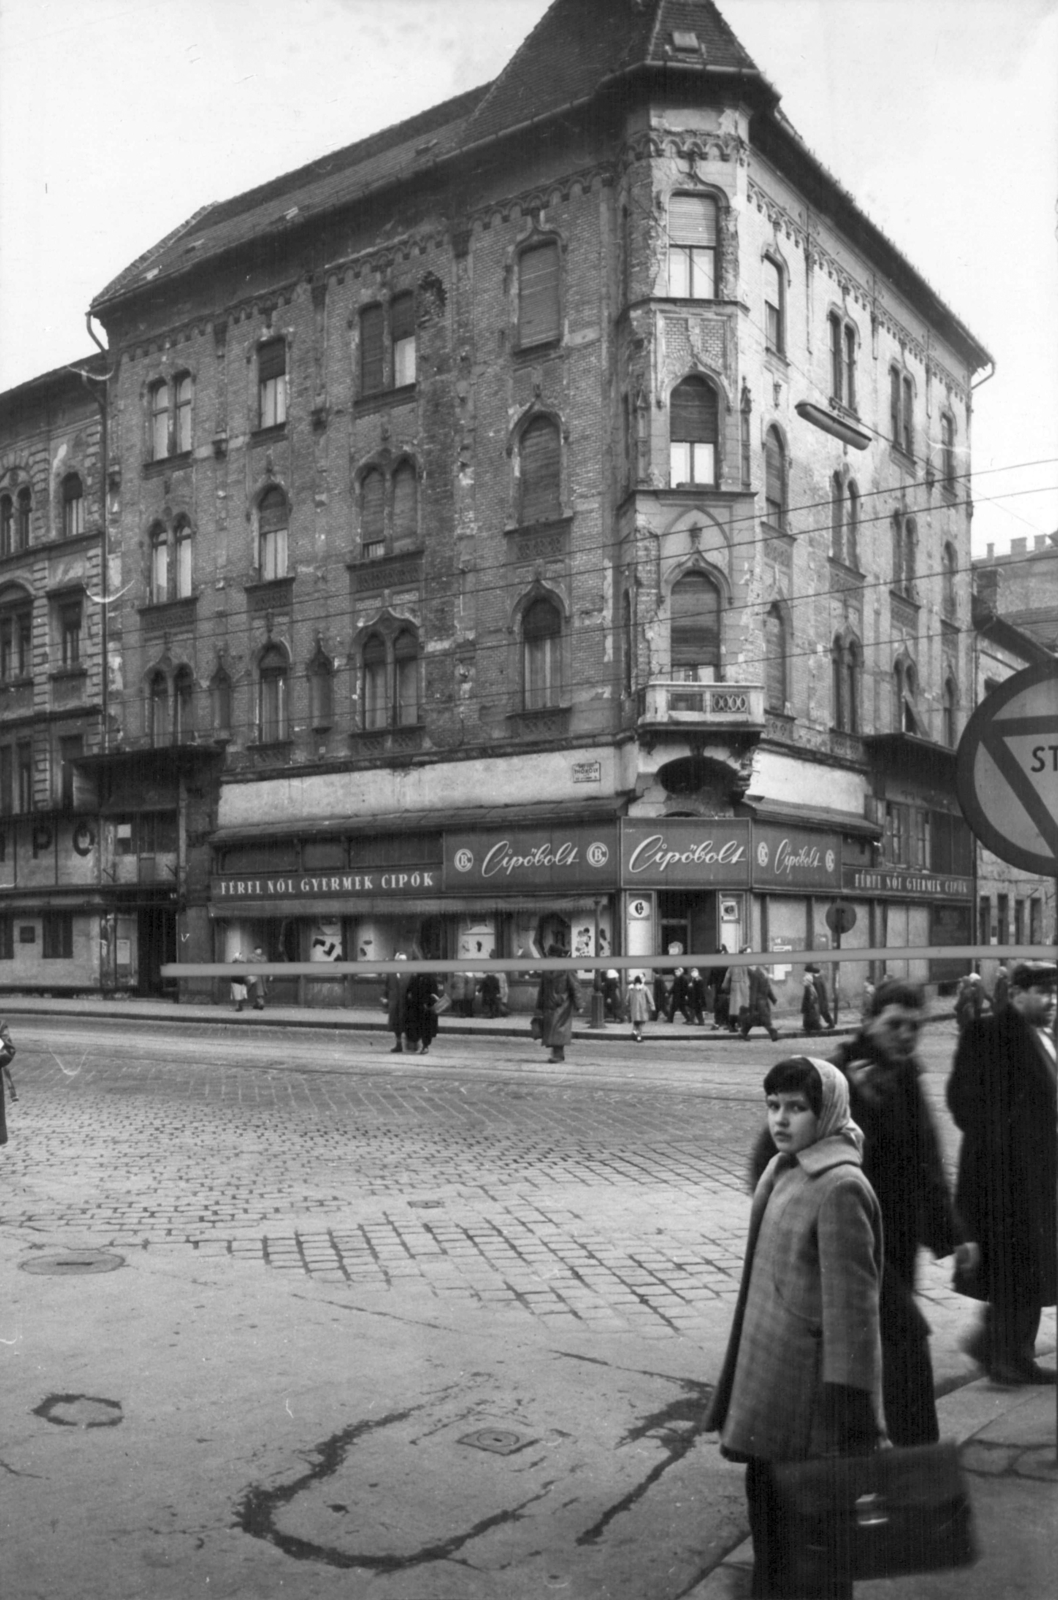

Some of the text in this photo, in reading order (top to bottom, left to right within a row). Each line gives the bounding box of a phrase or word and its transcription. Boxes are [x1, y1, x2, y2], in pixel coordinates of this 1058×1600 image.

[1030, 746, 1058, 772] ST
[481, 840, 580, 878] Cipőbolt
[629, 834, 747, 873] Cipőbolt
[774, 838, 822, 874] Cipőbolt
[300, 876, 374, 892] GYERMEK
[381, 871, 433, 889] CIPŐK
[906, 878, 941, 892] GYERMEK
